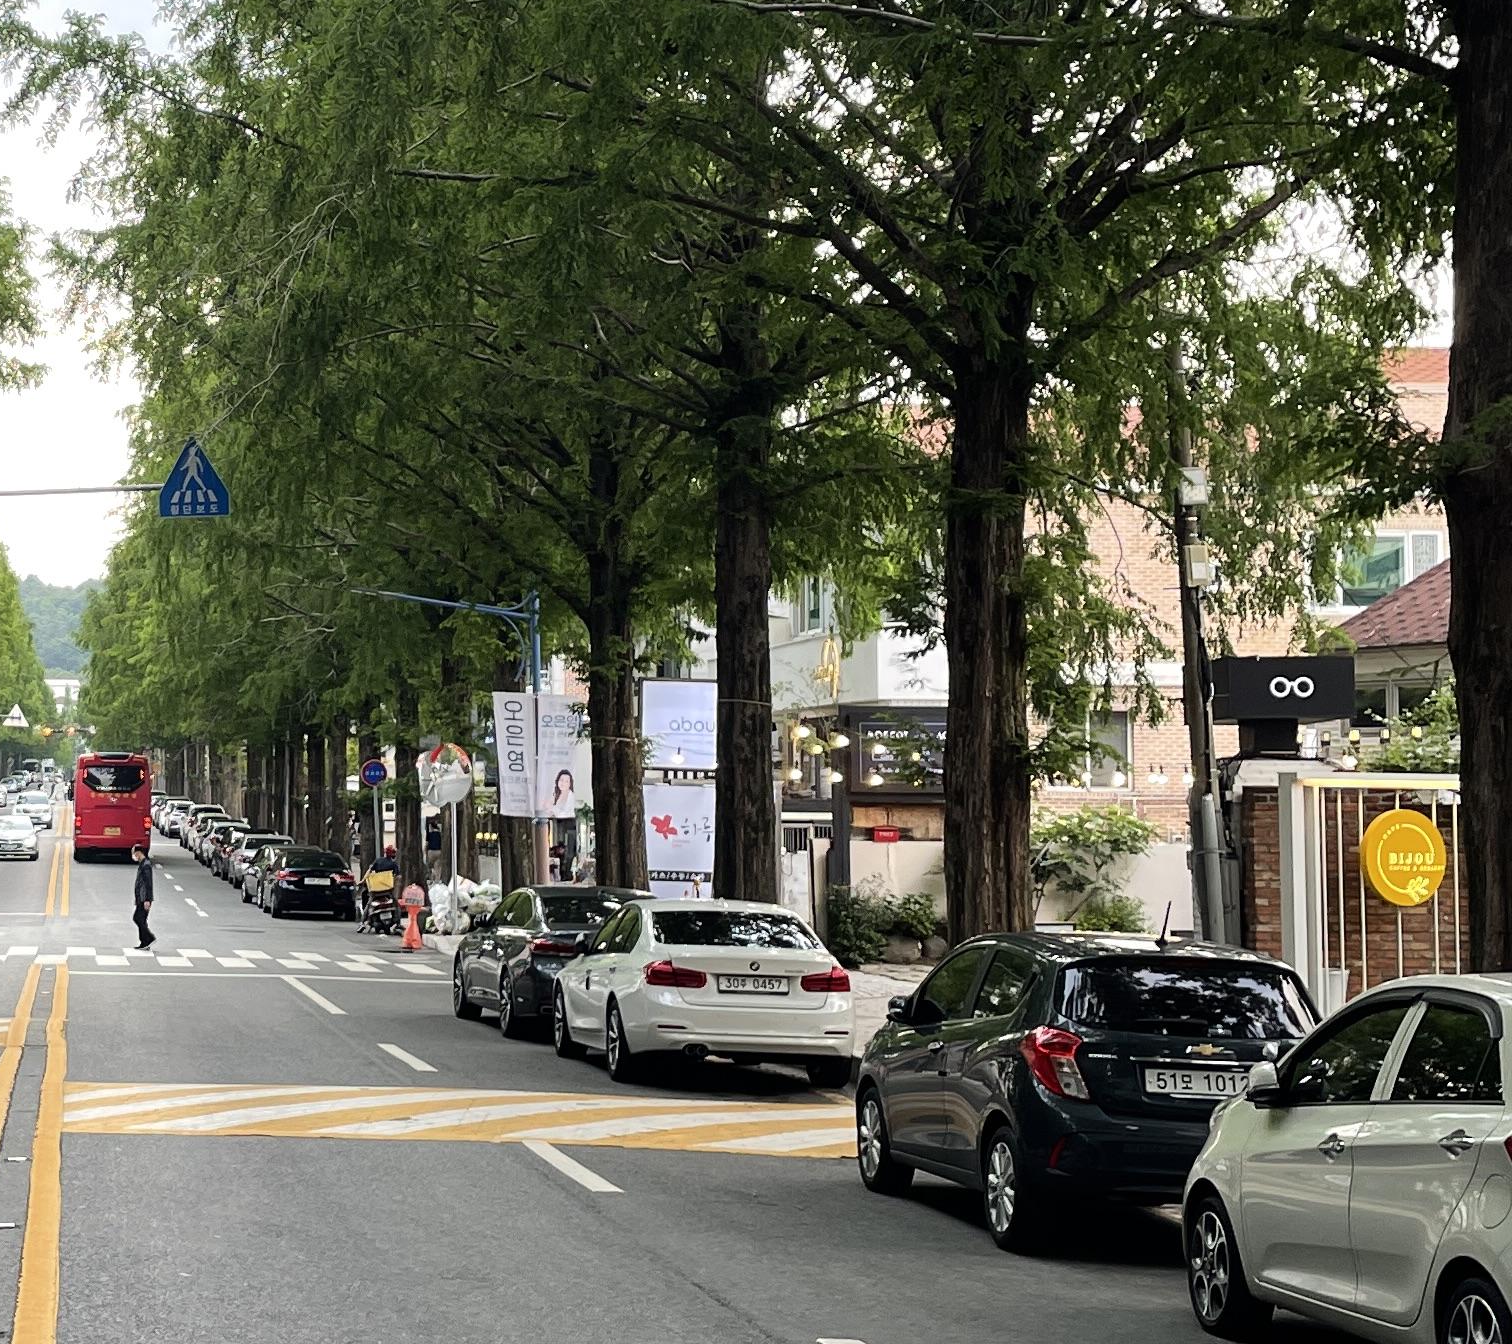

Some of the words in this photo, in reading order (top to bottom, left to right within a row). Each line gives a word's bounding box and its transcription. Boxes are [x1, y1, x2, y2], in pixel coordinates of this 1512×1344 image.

[1389, 852, 1435, 865] BIJOU
[752, 978, 783, 990] 0457
[1156, 1072, 1193, 1090] 51모
[1203, 1073, 1250, 1093] 1012
